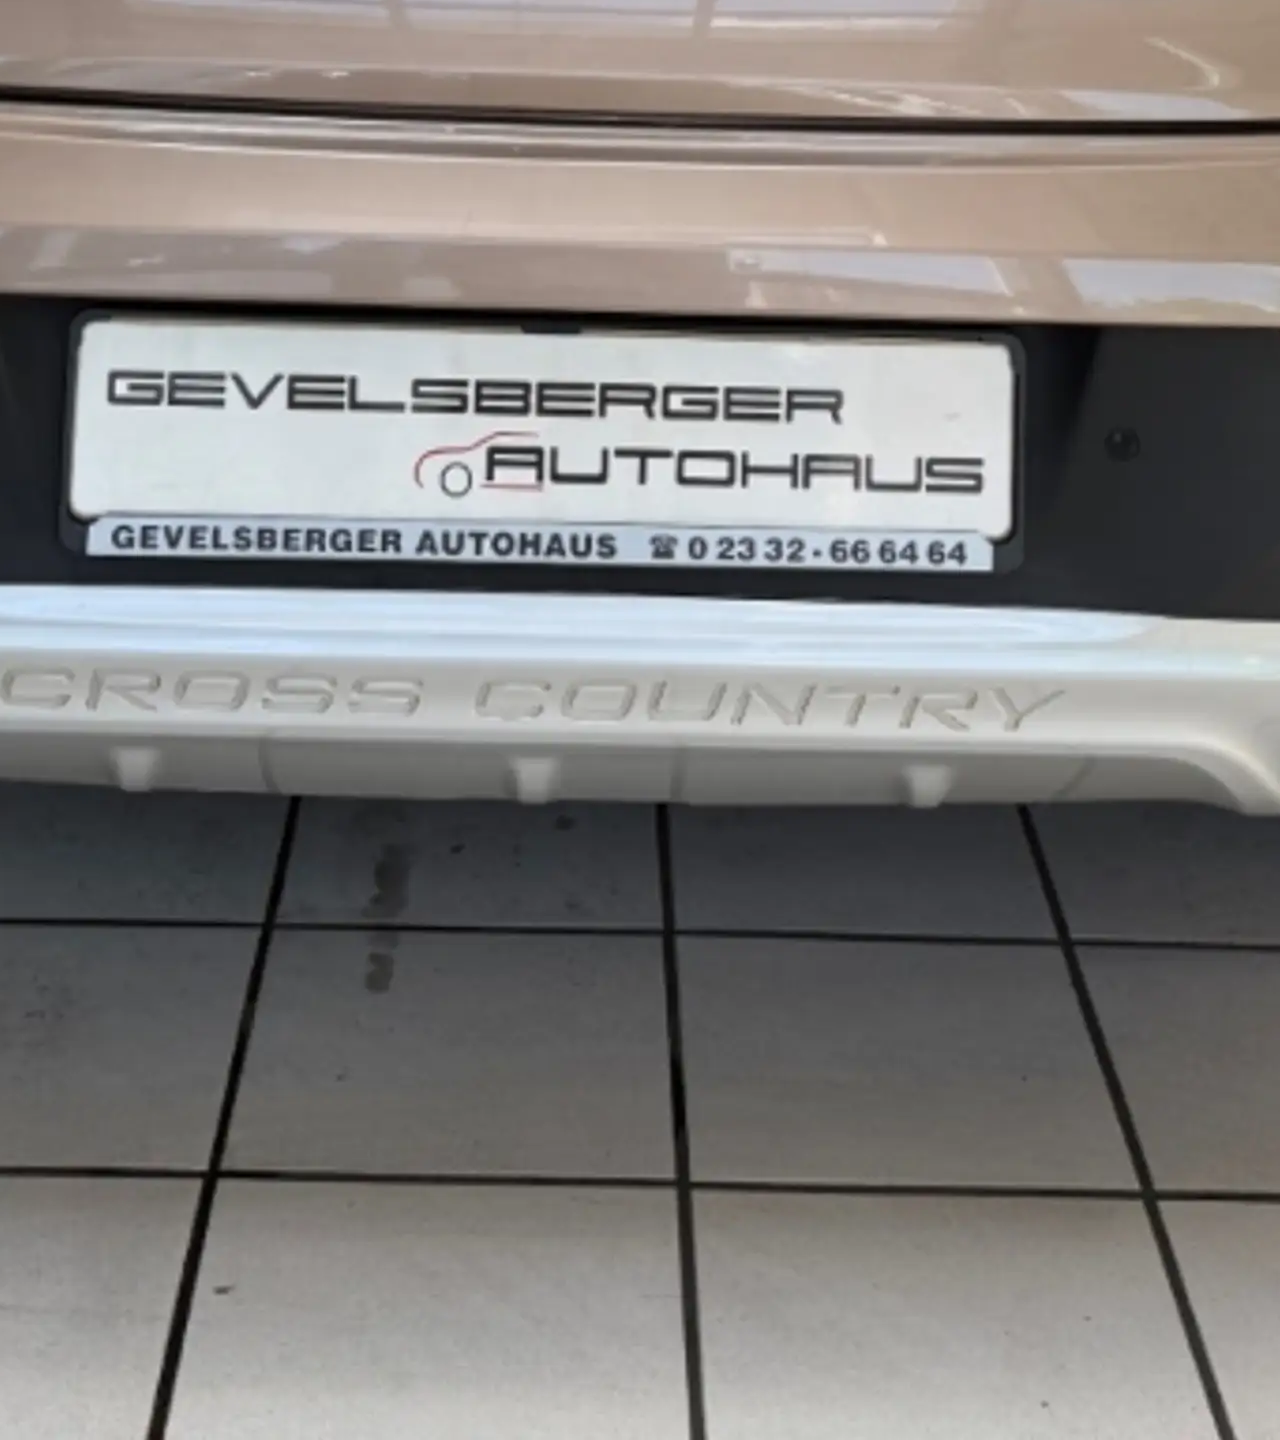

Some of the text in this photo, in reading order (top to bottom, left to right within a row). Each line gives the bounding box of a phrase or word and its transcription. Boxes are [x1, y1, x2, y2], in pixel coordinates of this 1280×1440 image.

[106, 368, 845, 425] GEVELSBERGER
[484, 444, 985, 494] AUTOHAUS
[109, 523, 403, 555] GEVELSBERGER
[414, 528, 619, 560] AUTOHAUS
[473, 678, 1067, 732] COUNTRY
